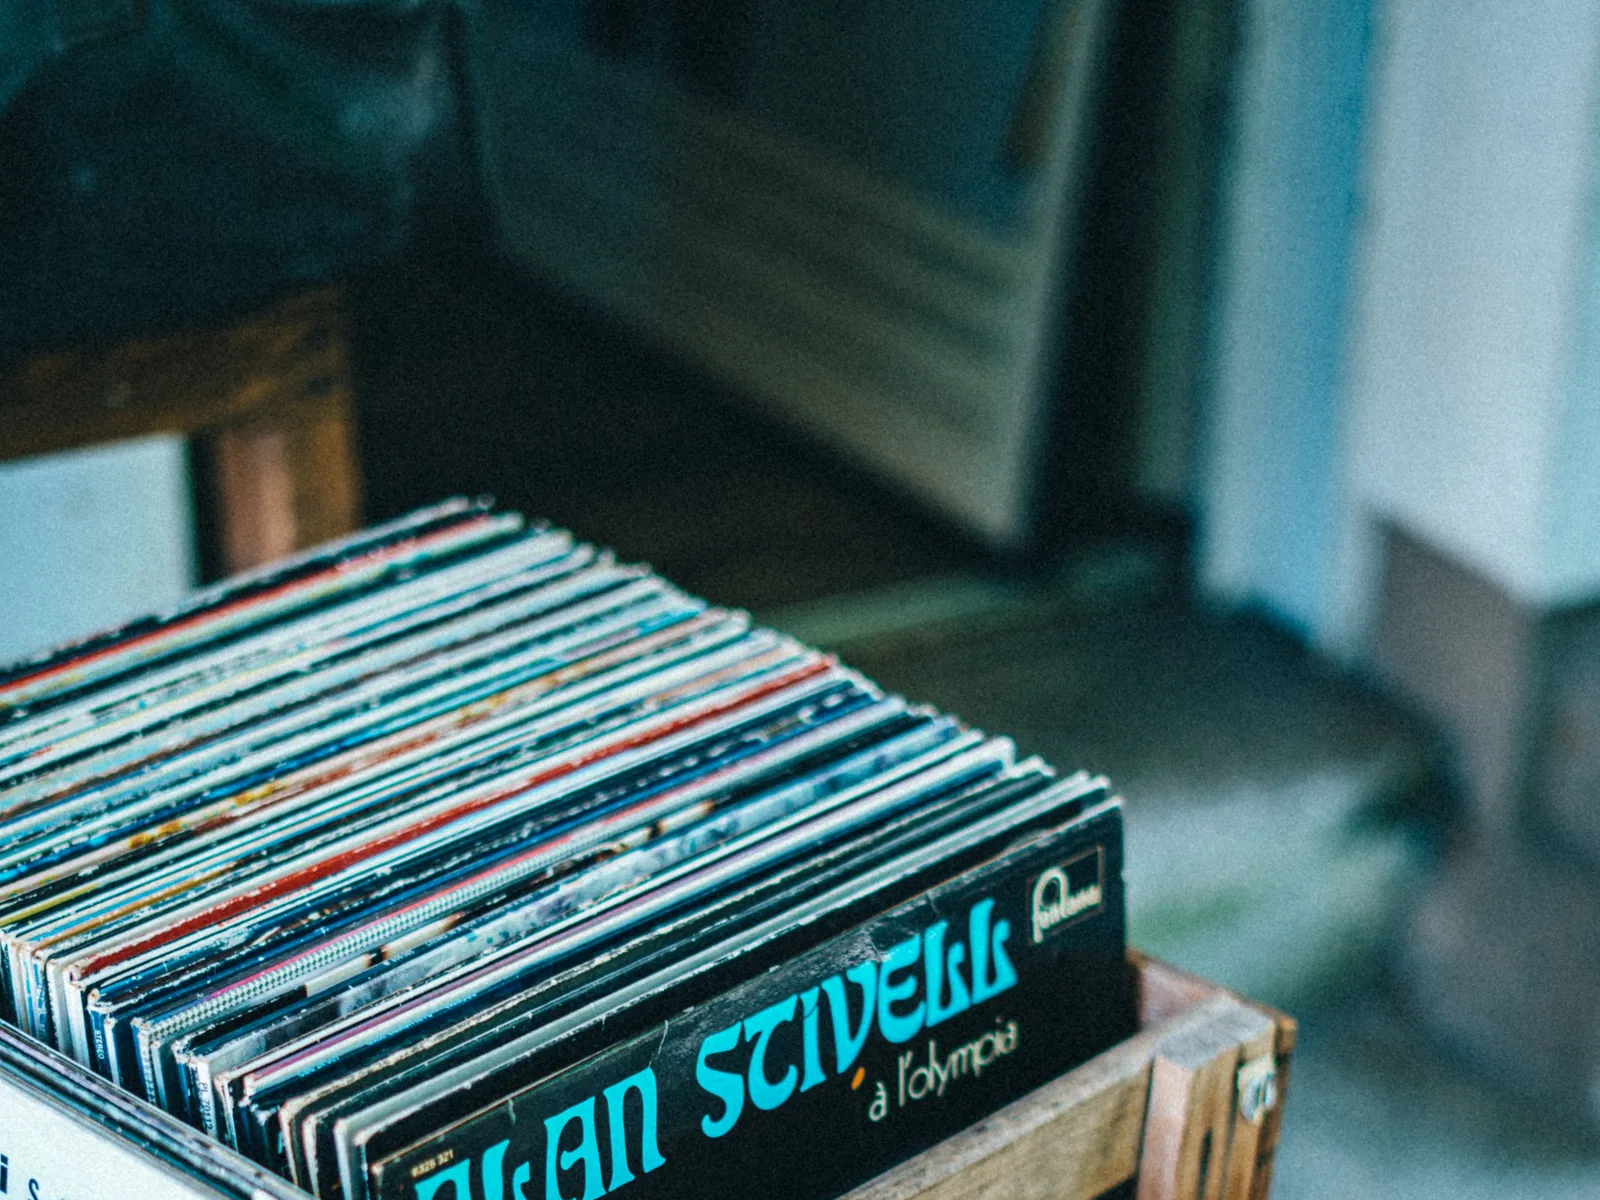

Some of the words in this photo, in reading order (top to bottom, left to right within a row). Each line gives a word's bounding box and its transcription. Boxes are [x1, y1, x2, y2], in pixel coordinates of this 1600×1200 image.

[695, 897, 1018, 1138] STIVELL
[869, 1081, 887, 1122] à
[898, 1016, 1017, 1107] l'olympia
